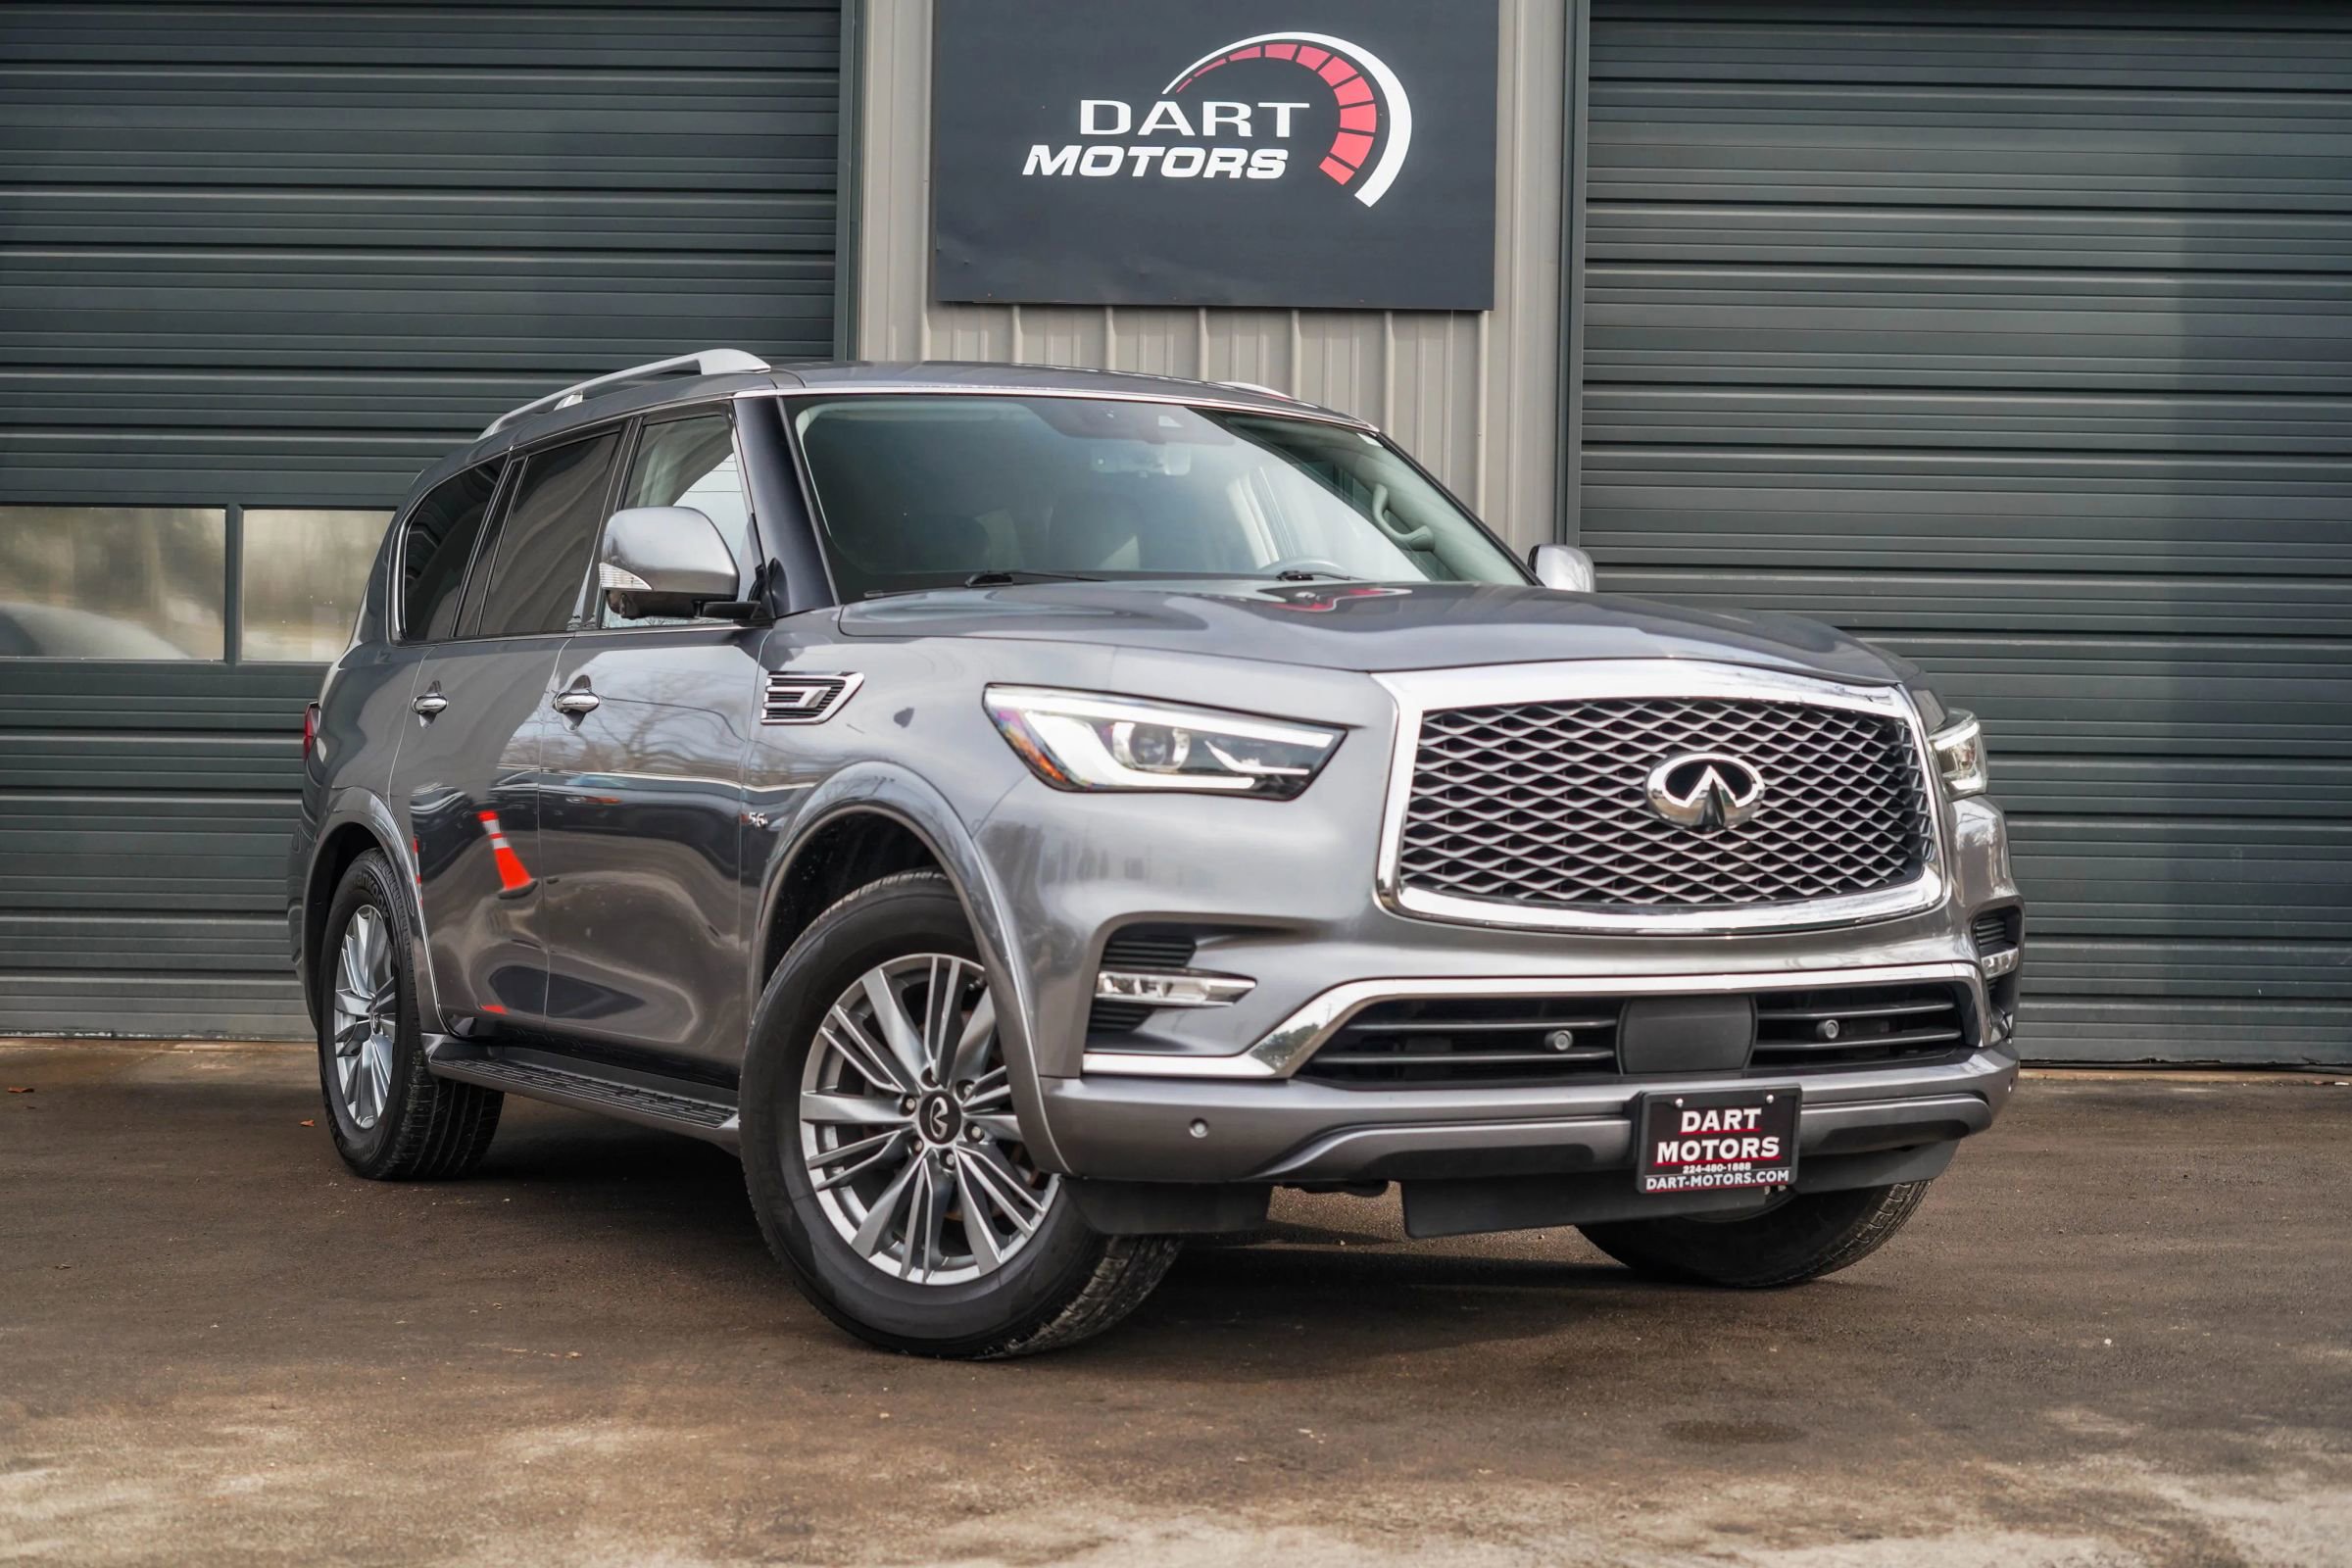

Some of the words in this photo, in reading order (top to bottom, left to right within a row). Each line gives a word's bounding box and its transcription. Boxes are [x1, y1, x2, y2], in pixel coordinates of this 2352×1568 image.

[1080, 99, 1310, 138] DART
[1022, 144, 1289, 179] MOTORS
[1681, 1107, 1762, 1133] DART
[1657, 1137, 1780, 1163] MOTORS
[1645, 1169, 1789, 1191] DART-MOTORS.COM
